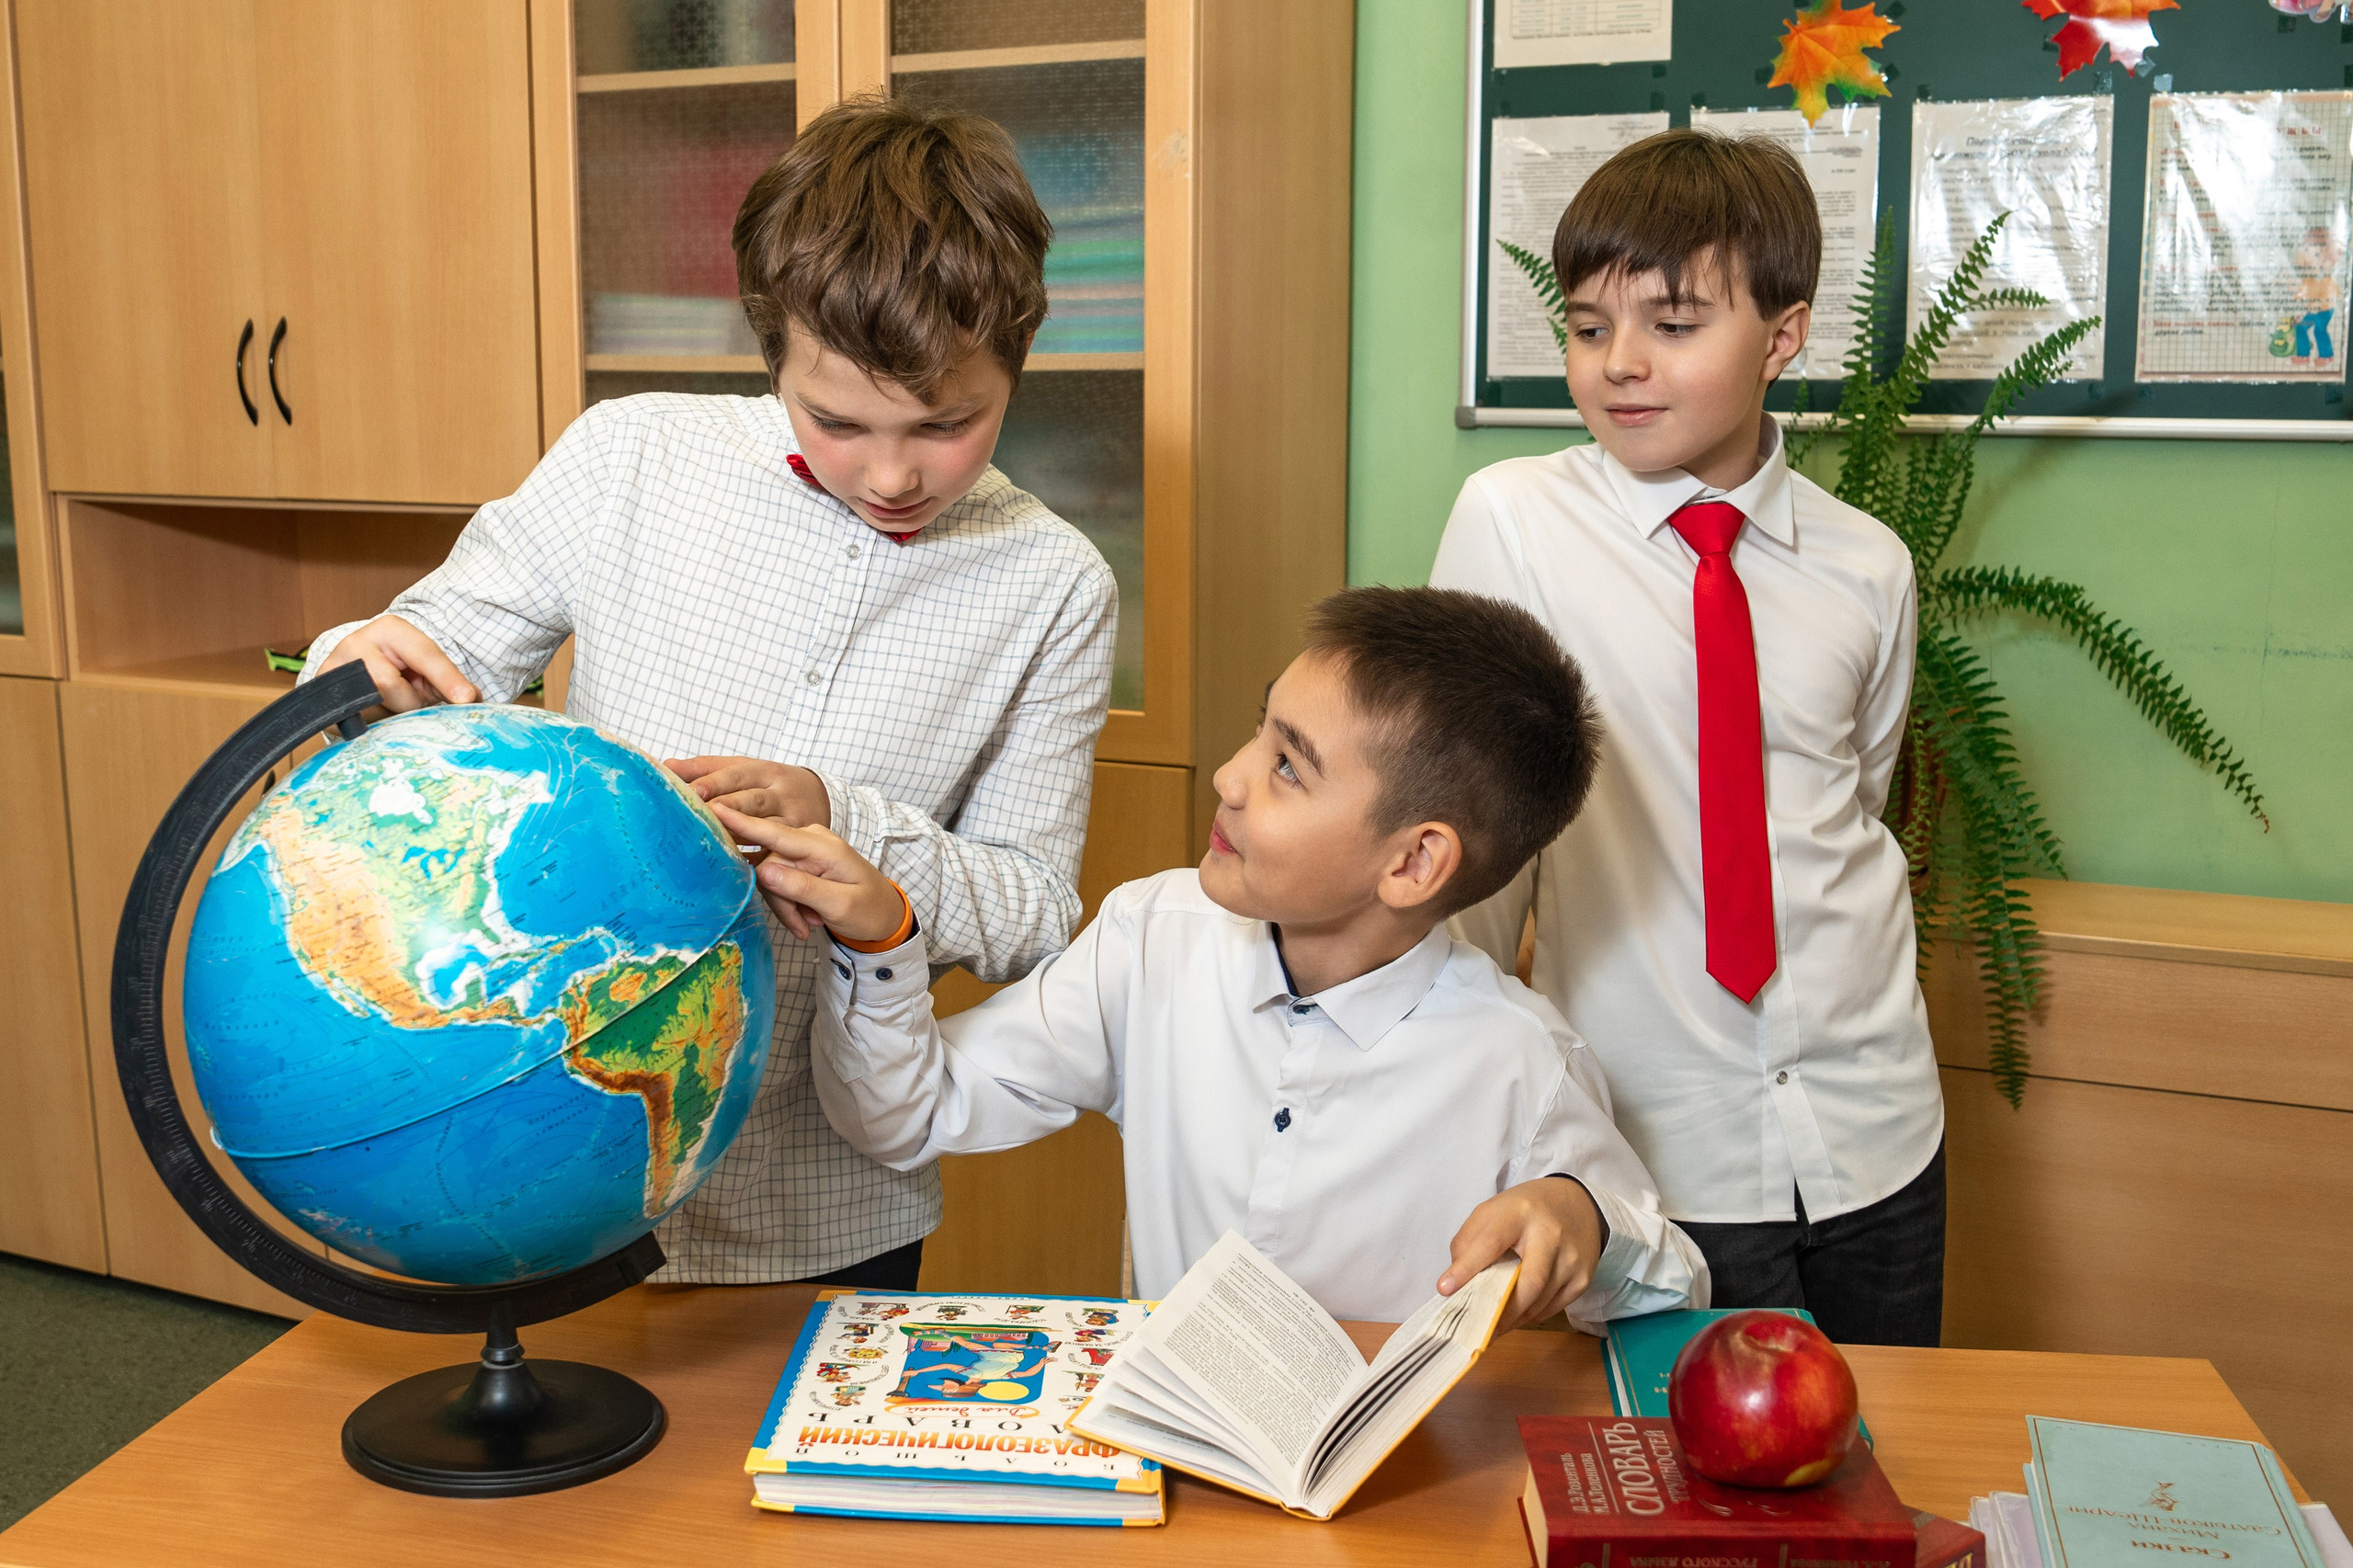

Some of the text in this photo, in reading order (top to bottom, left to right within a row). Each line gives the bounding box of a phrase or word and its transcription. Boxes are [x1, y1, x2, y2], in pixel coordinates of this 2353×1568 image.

[808, 1411, 1067, 1435] ЛОВАРЬ
[904, 1405, 971, 1418] детей
[798, 1426, 1121, 1459] ФРАЗЕОЛОГИЧЕСКИЙ
[795, 1447, 1116, 1471] БОЛЬШОЙ
[1602, 1422, 1665, 1517] СЛОВАРЬ
[1643, 1429, 1690, 1505] ТРУДНОСТЕЙ
[2127, 1521, 2220, 1540] Михаил
[1630, 1555, 1759, 1568] РУССКОГО ЯЗЫКА
[2131, 1540, 2231, 1561] Сказки
